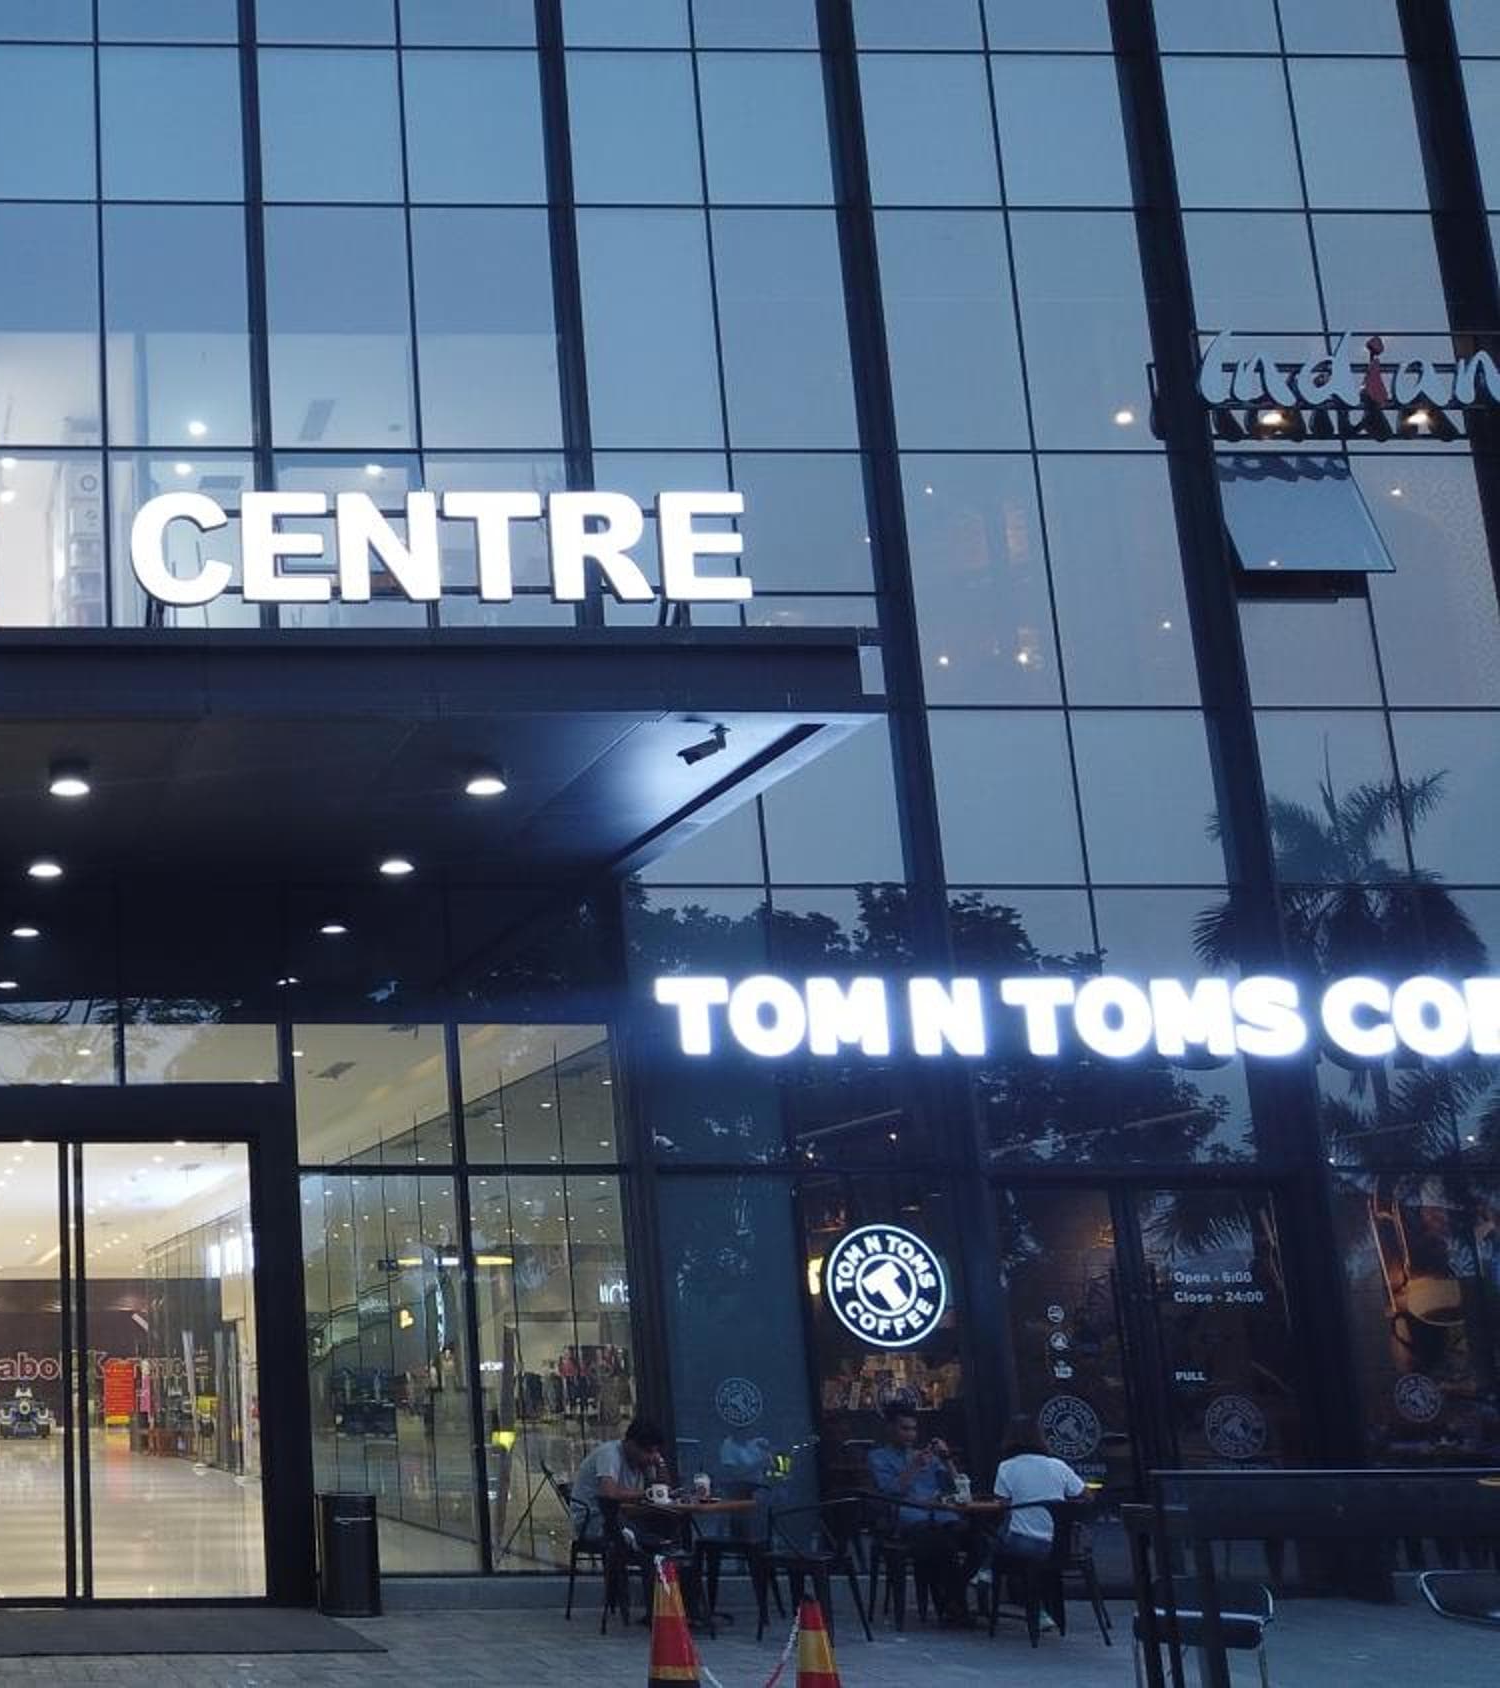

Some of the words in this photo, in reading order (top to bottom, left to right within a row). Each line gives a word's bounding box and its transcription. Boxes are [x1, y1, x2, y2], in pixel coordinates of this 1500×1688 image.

[129, 488, 756, 606] CENTRE
[655, 975, 891, 1058] TOM
[908, 975, 988, 1058] N
[1001, 974, 1308, 1058] TOMS
[837, 1245, 865, 1292] TOM
[864, 1235, 882, 1253] N
[885, 1235, 936, 1288] TOMS
[1173, 1271, 1211, 1284] Open
[1173, 1291, 1212, 1303] Close
[1225, 1291, 1263, 1303] 24:00
[846, 1298, 934, 1335] COFFEE
[1175, 1370, 1205, 1381] PULL
